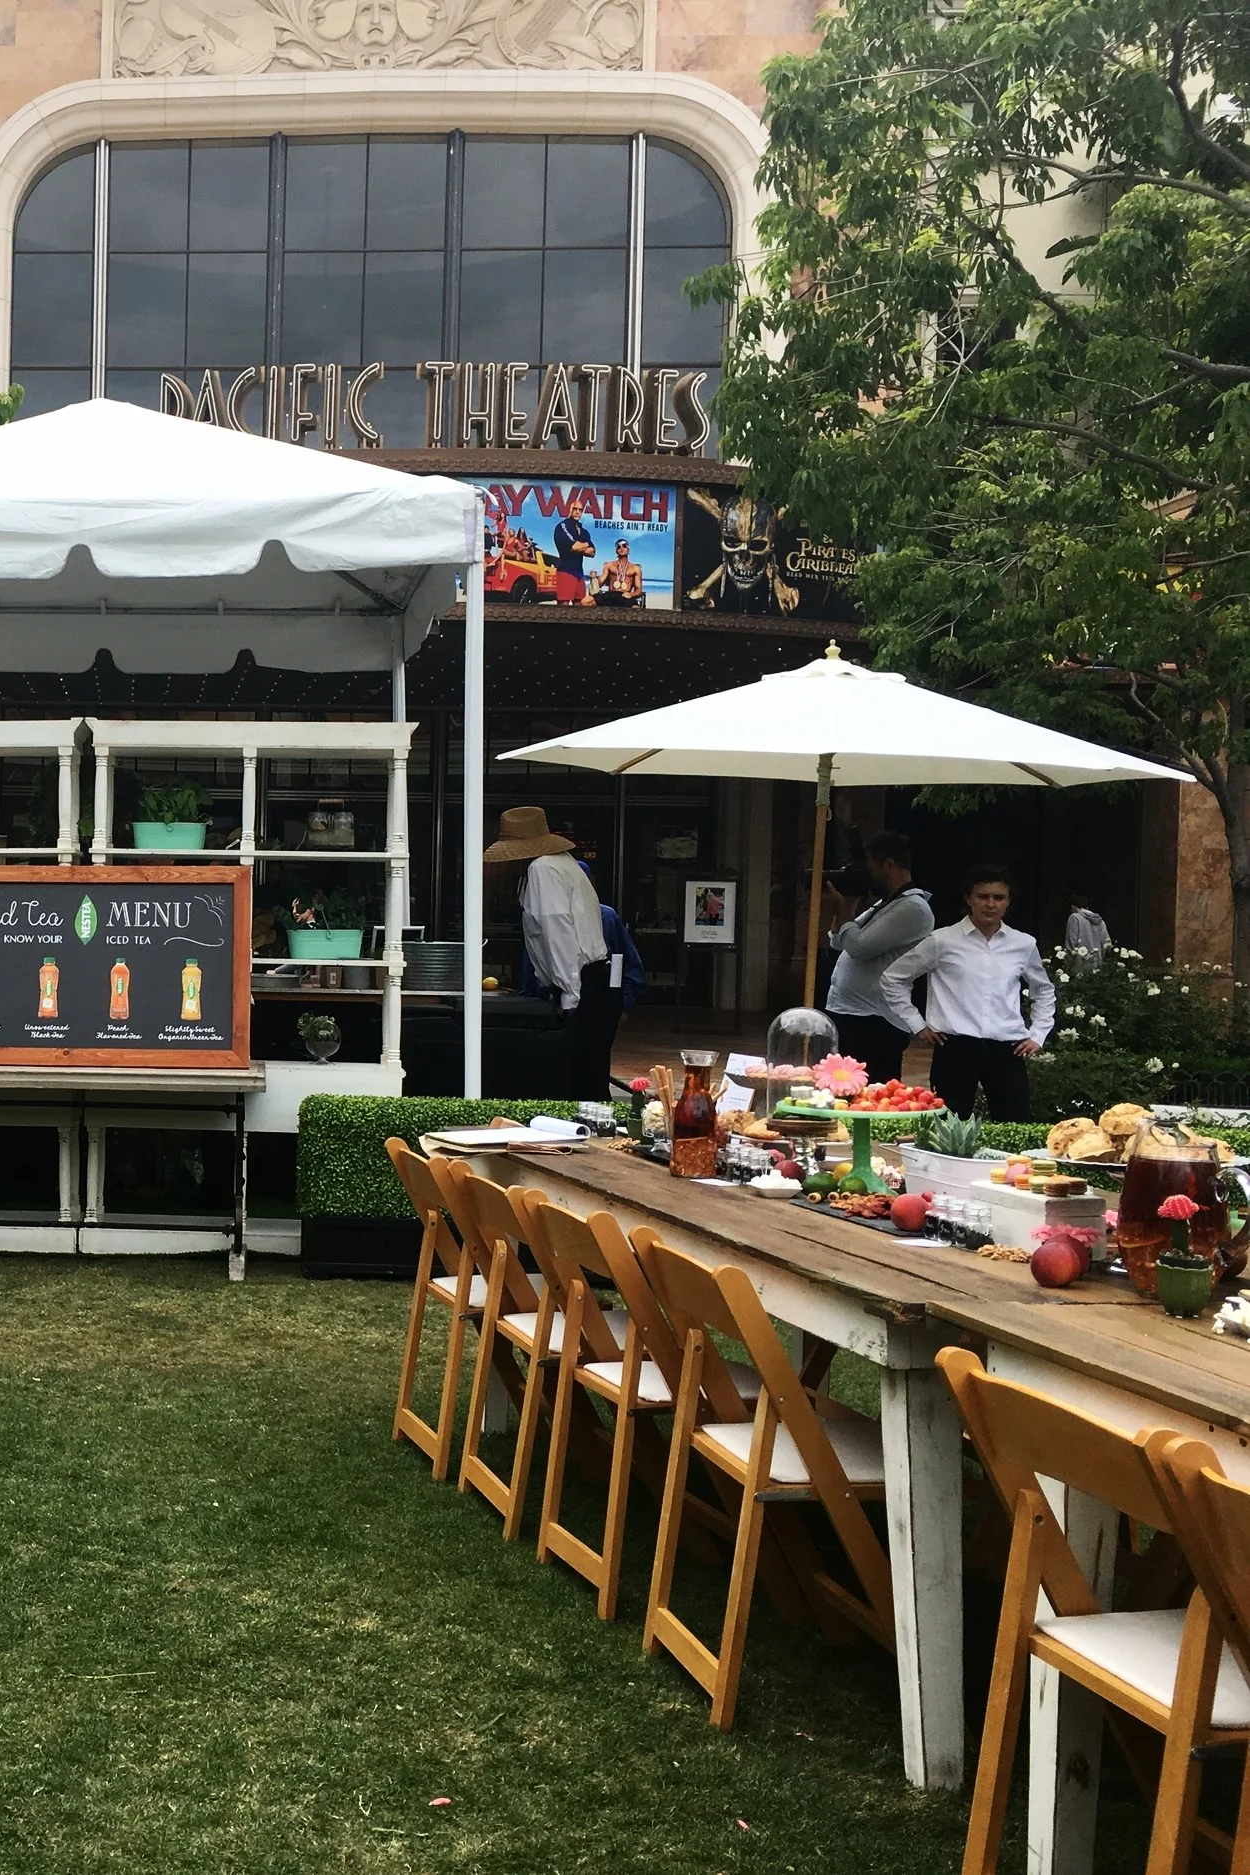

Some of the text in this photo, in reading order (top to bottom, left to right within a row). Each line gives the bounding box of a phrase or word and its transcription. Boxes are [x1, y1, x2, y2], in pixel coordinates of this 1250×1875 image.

[160, 361, 710, 450] PACIFIC THEATRES
[485, 484, 670, 523] AYWATCH
[594, 520, 668, 533] BEACHES AIN'T READY
[796, 537, 856, 562] PIRAES
[22, 900, 63, 926] Tea
[81, 902, 91, 938] NESTEA
[106, 901, 191, 928] MENU
[3, 934, 63, 944] KNOW YOUR
[106, 935, 152, 945] ICED TEA
